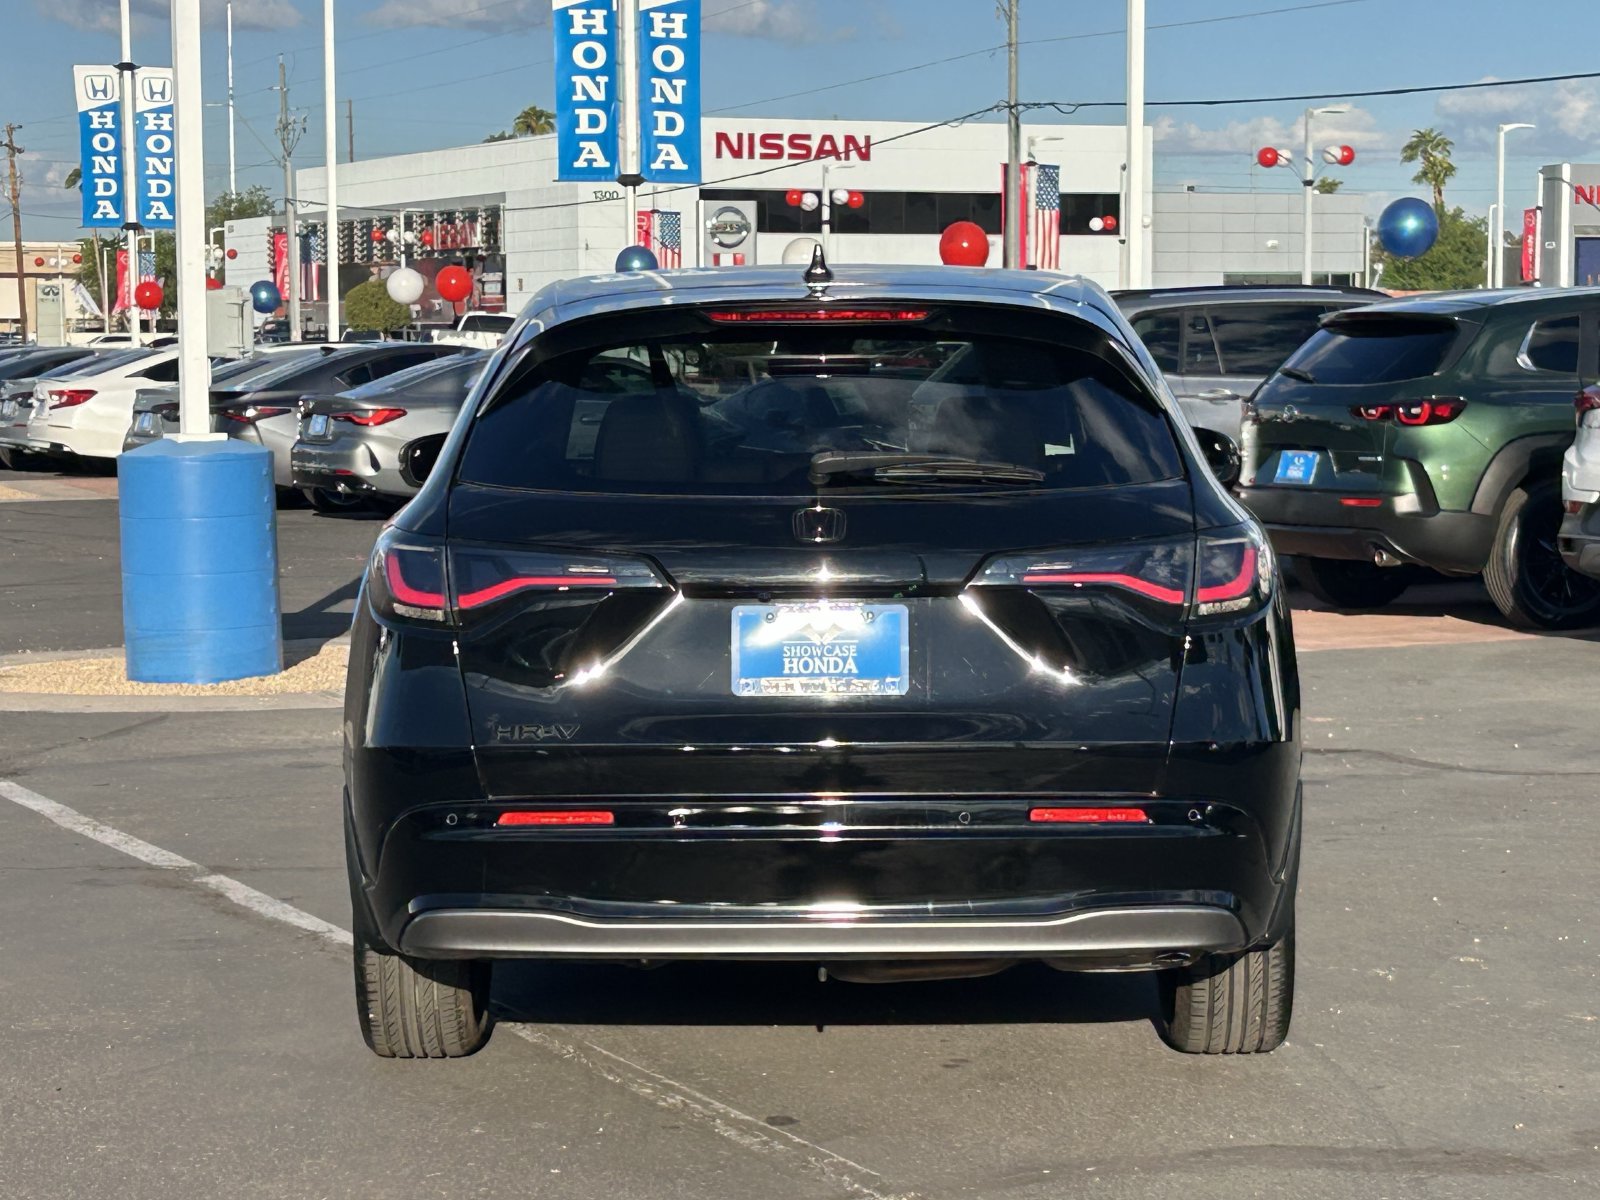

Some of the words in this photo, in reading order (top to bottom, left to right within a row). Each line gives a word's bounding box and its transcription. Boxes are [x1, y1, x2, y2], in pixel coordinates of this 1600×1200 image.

[568, 9, 610, 168] HONDA
[649, 12, 688, 170] HONDA
[88, 111, 119, 219] HONDA
[143, 112, 174, 220] HONDA
[715, 131, 871, 161] NISSAN
[593, 190, 619, 200] 1300
[782, 645, 858, 657] SHOWCASE
[782, 657, 859, 674] HONDA
